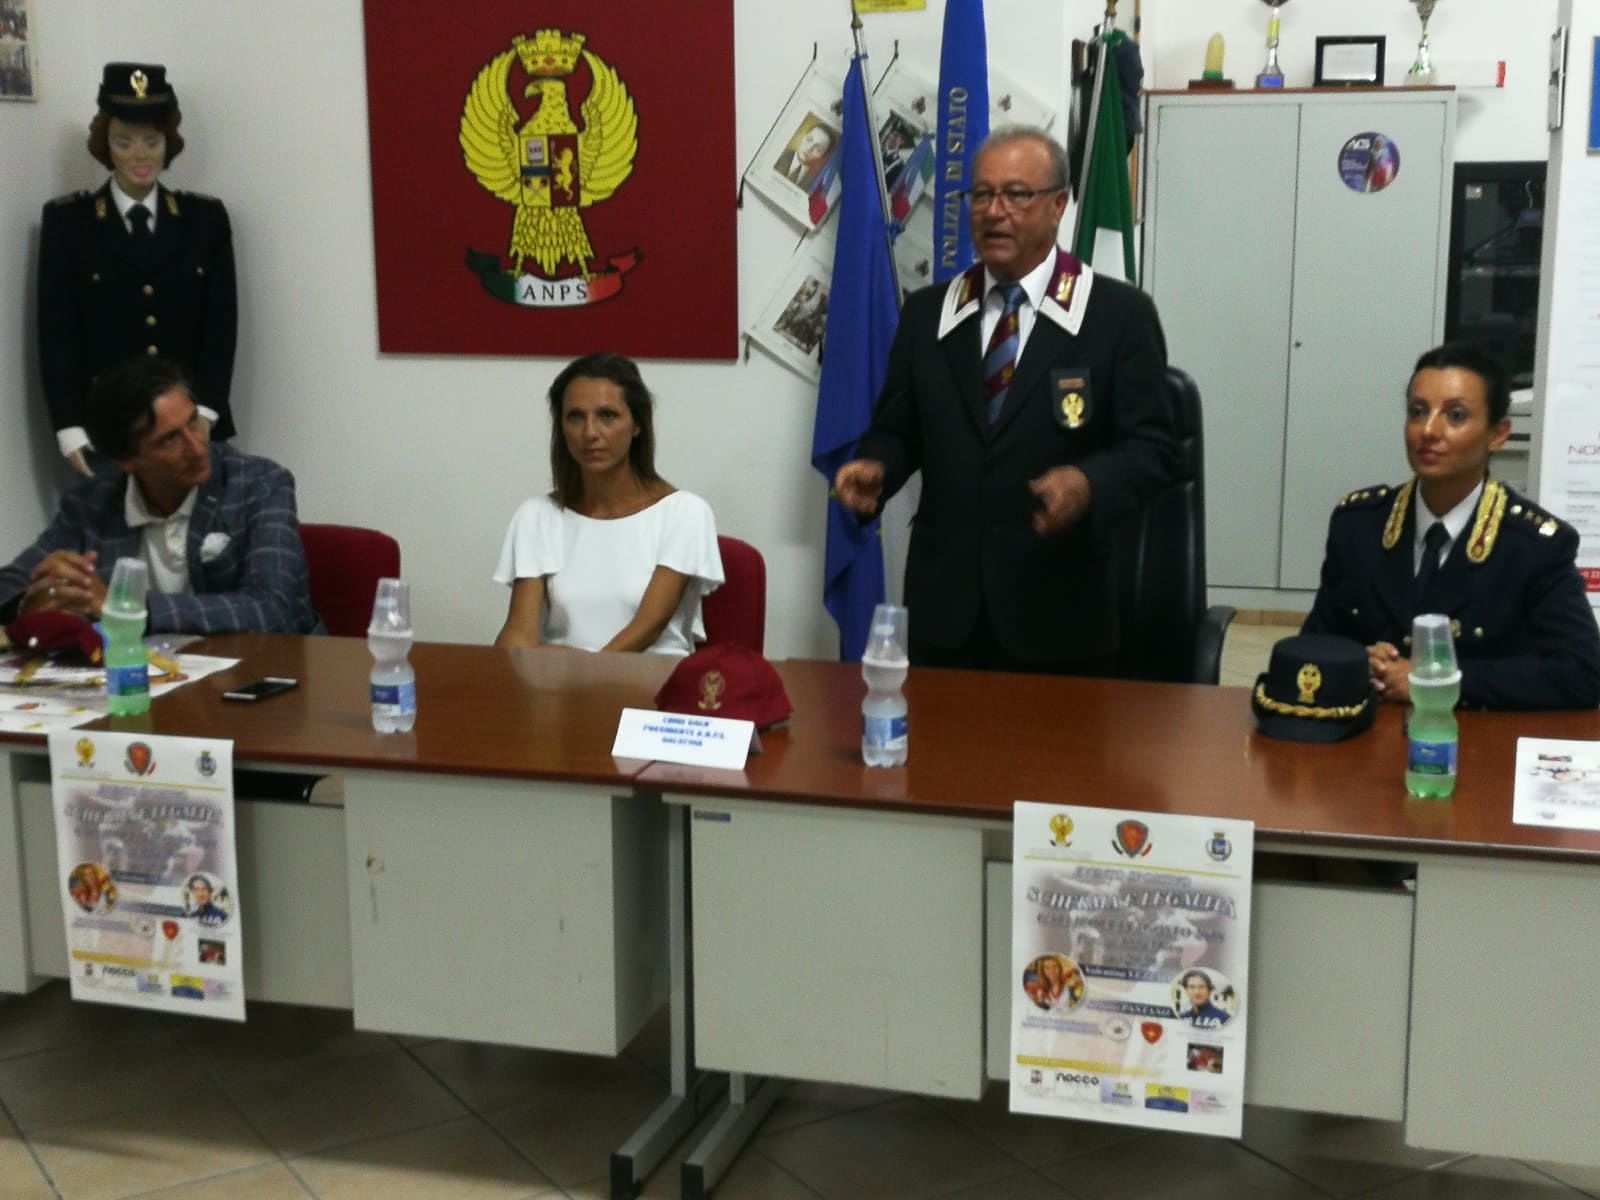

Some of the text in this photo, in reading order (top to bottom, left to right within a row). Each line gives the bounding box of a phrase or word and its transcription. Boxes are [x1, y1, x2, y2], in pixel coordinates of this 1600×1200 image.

[942, 87, 968, 268] POLIZIA DI STATO
[522, 284, 588, 301] ANPS
